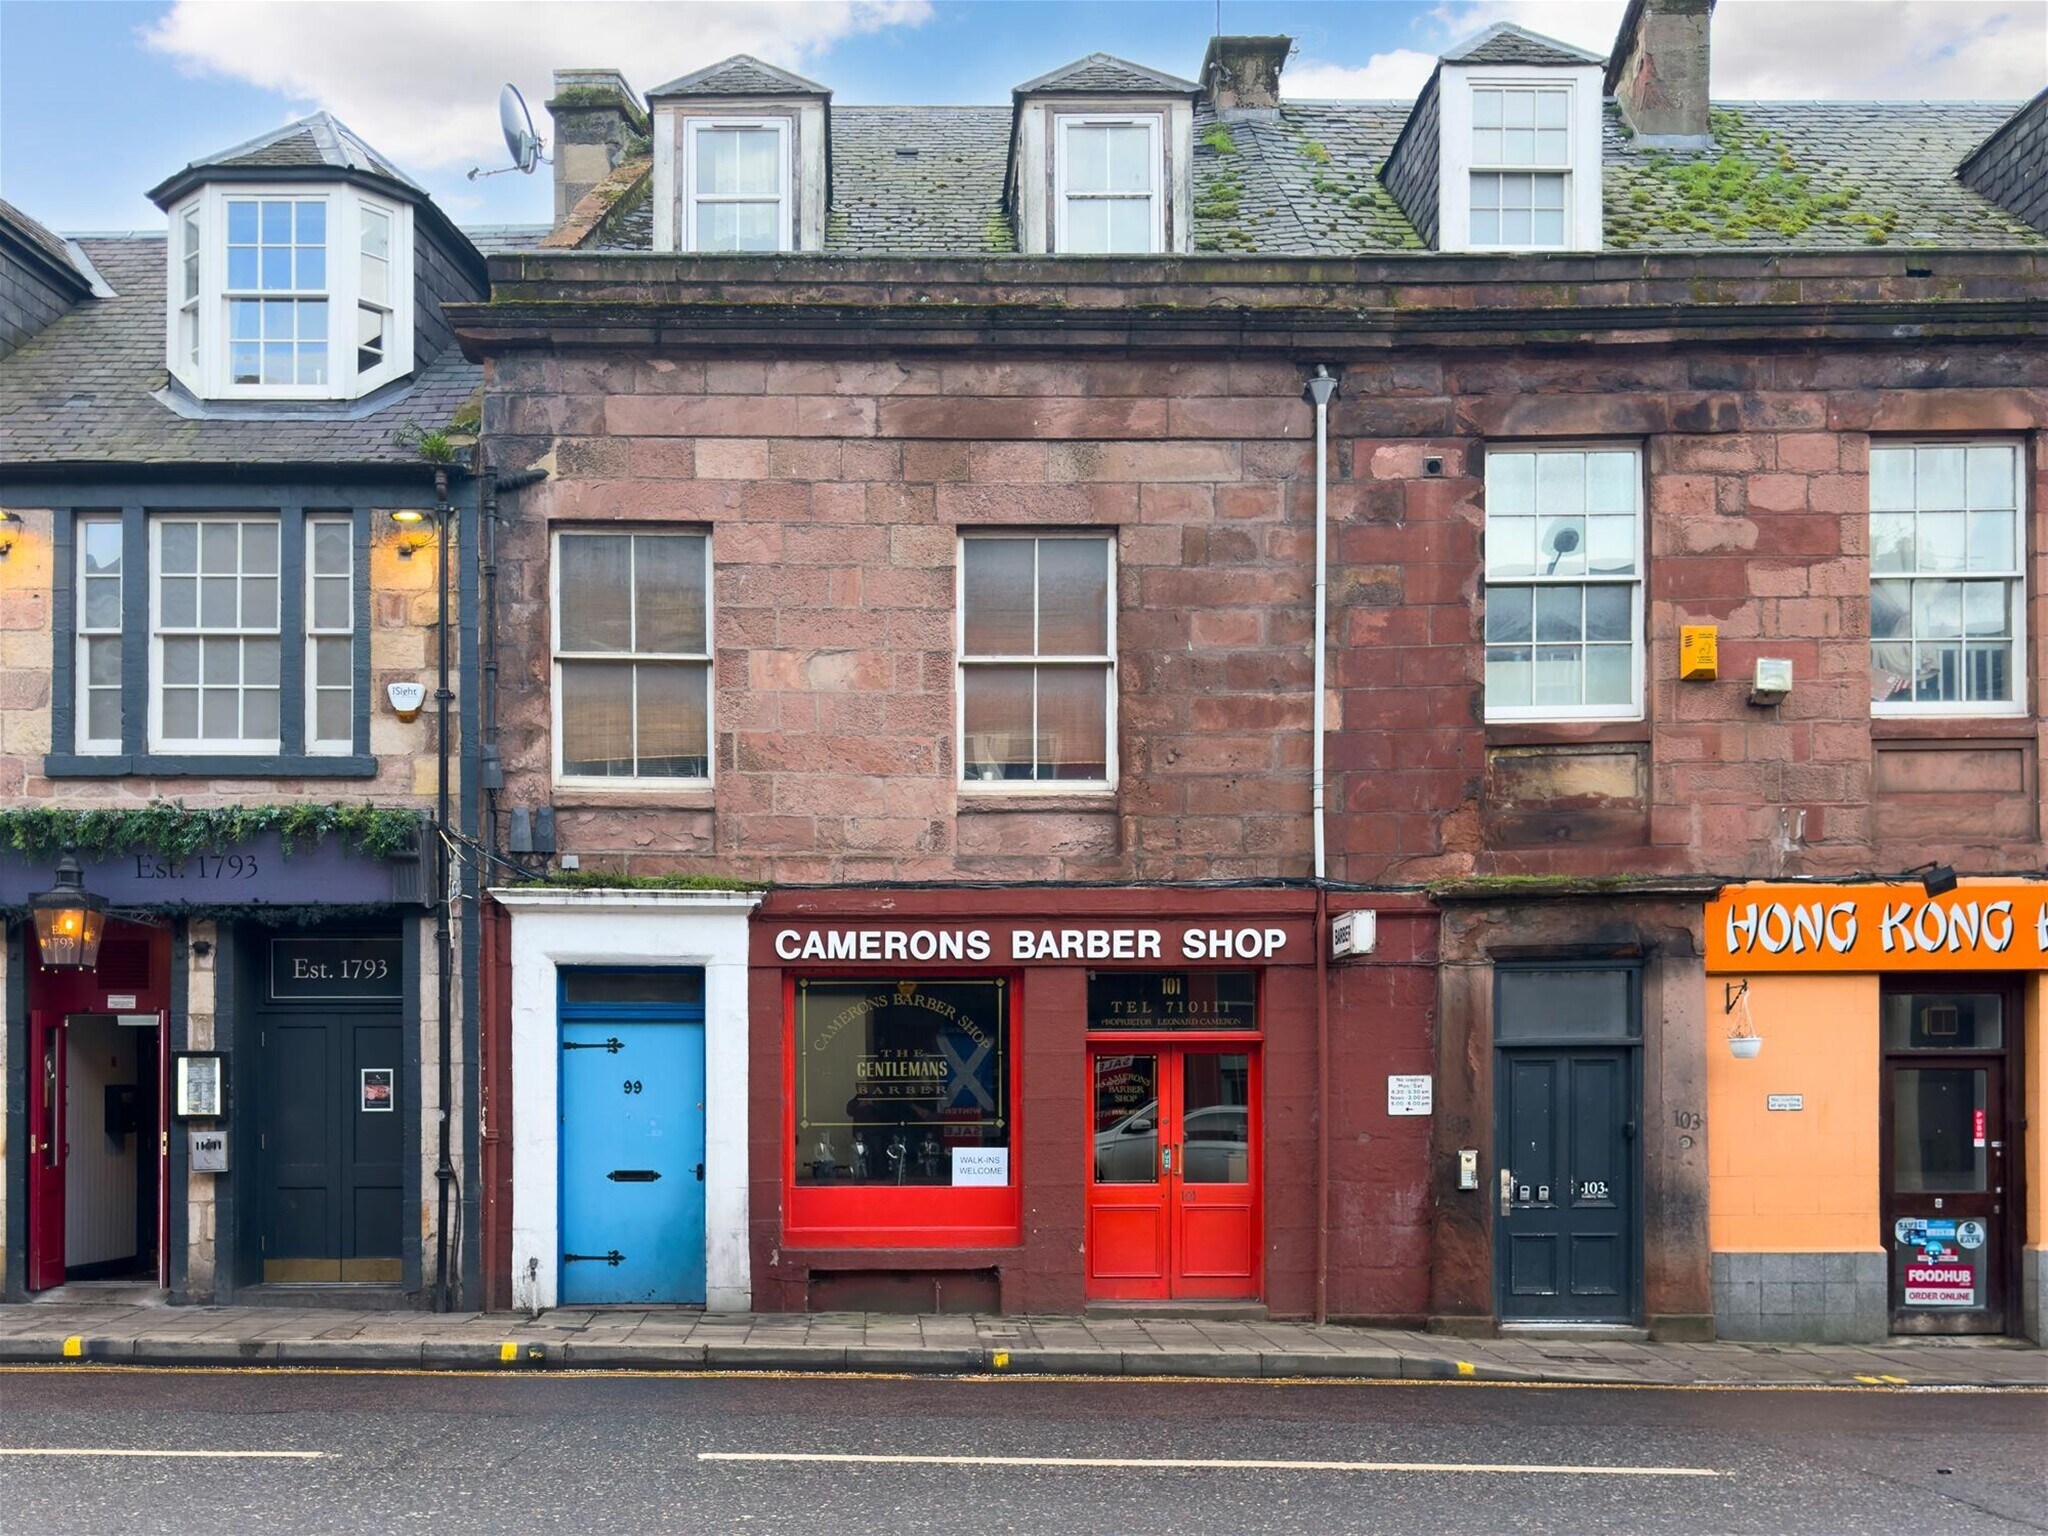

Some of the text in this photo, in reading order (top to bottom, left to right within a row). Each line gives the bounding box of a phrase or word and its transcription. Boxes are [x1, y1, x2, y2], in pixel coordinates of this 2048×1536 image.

[135, 854, 258, 879] Est. 1793
[1726, 901, 1858, 954] HONG
[1877, 900, 2014, 953] KONG
[1335, 925, 1350, 945] BARBER
[775, 928, 1287, 961] CAMERONS BARBER SHOP
[292, 958, 388, 979] Est. 1793
[1161, 977, 1181, 995] 101
[1111, 1001, 1230, 1013] TEL 710111
[813, 993, 991, 1052] CAMERONS BARBER SHOP
[1157, 1018, 1198, 1026] LEONARD
[1199, 1018, 1241, 1026] CAMERON
[880, 1049, 924, 1058] THE
[857, 1061, 948, 1077] GENTLEMANS
[624, 1080, 643, 1094] 99
[858, 1086, 948, 1095] BARBER
[1109, 1085, 1144, 1093] BARBER
[1115, 1094, 1137, 1102] SHOP
[1672, 1110, 1700, 1130] 103
[960, 1156, 1000, 1165] WALK-INS
[960, 1167, 1003, 1175] WELCOME
[1908, 1269, 1971, 1283] FOODHUB
[1908, 1292, 1970, 1300] ORDER ONLINE
